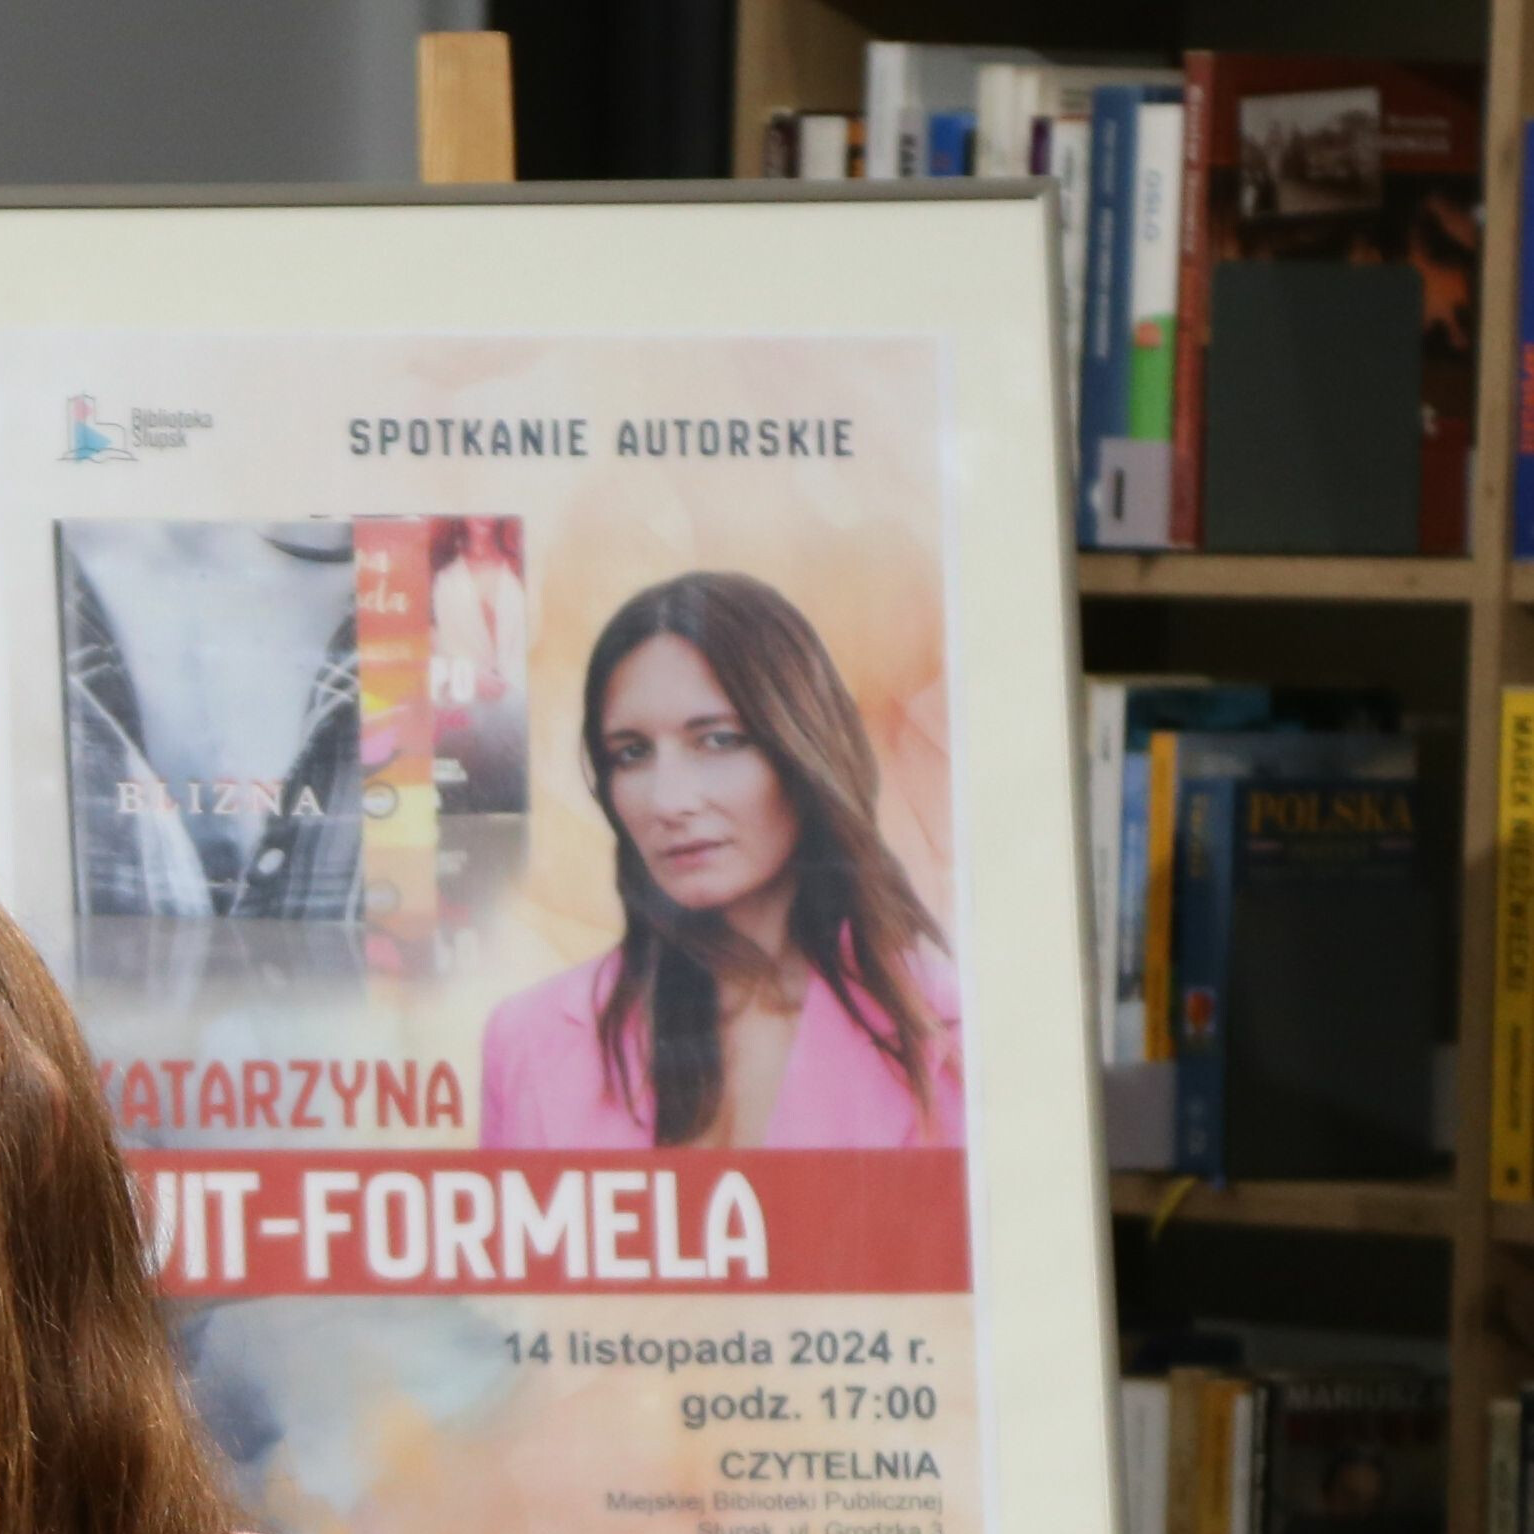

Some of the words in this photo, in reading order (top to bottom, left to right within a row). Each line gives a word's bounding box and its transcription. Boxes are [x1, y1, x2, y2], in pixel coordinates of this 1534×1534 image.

[131, 406, 214, 428] Biblioteka
[348, 417, 589, 457] SPOTKANIE
[616, 418, 855, 457] AUTORSKIE
[116, 780, 328, 818] BLIZNA
[503, 1331, 552, 1364] 14
[569, 1330, 774, 1372] listopada
[790, 1330, 893, 1364] 2024
[908, 1341, 934, 1364] r.
[680, 1387, 802, 1429] godz.
[819, 1385, 938, 1421] 17:00
[719, 1450, 941, 1481] CZYTELNIA
[606, 1490, 706, 1515] Miejskiej
[713, 1490, 815, 1512] Biblioteki
[824, 1489, 944, 1514] Publicznej
